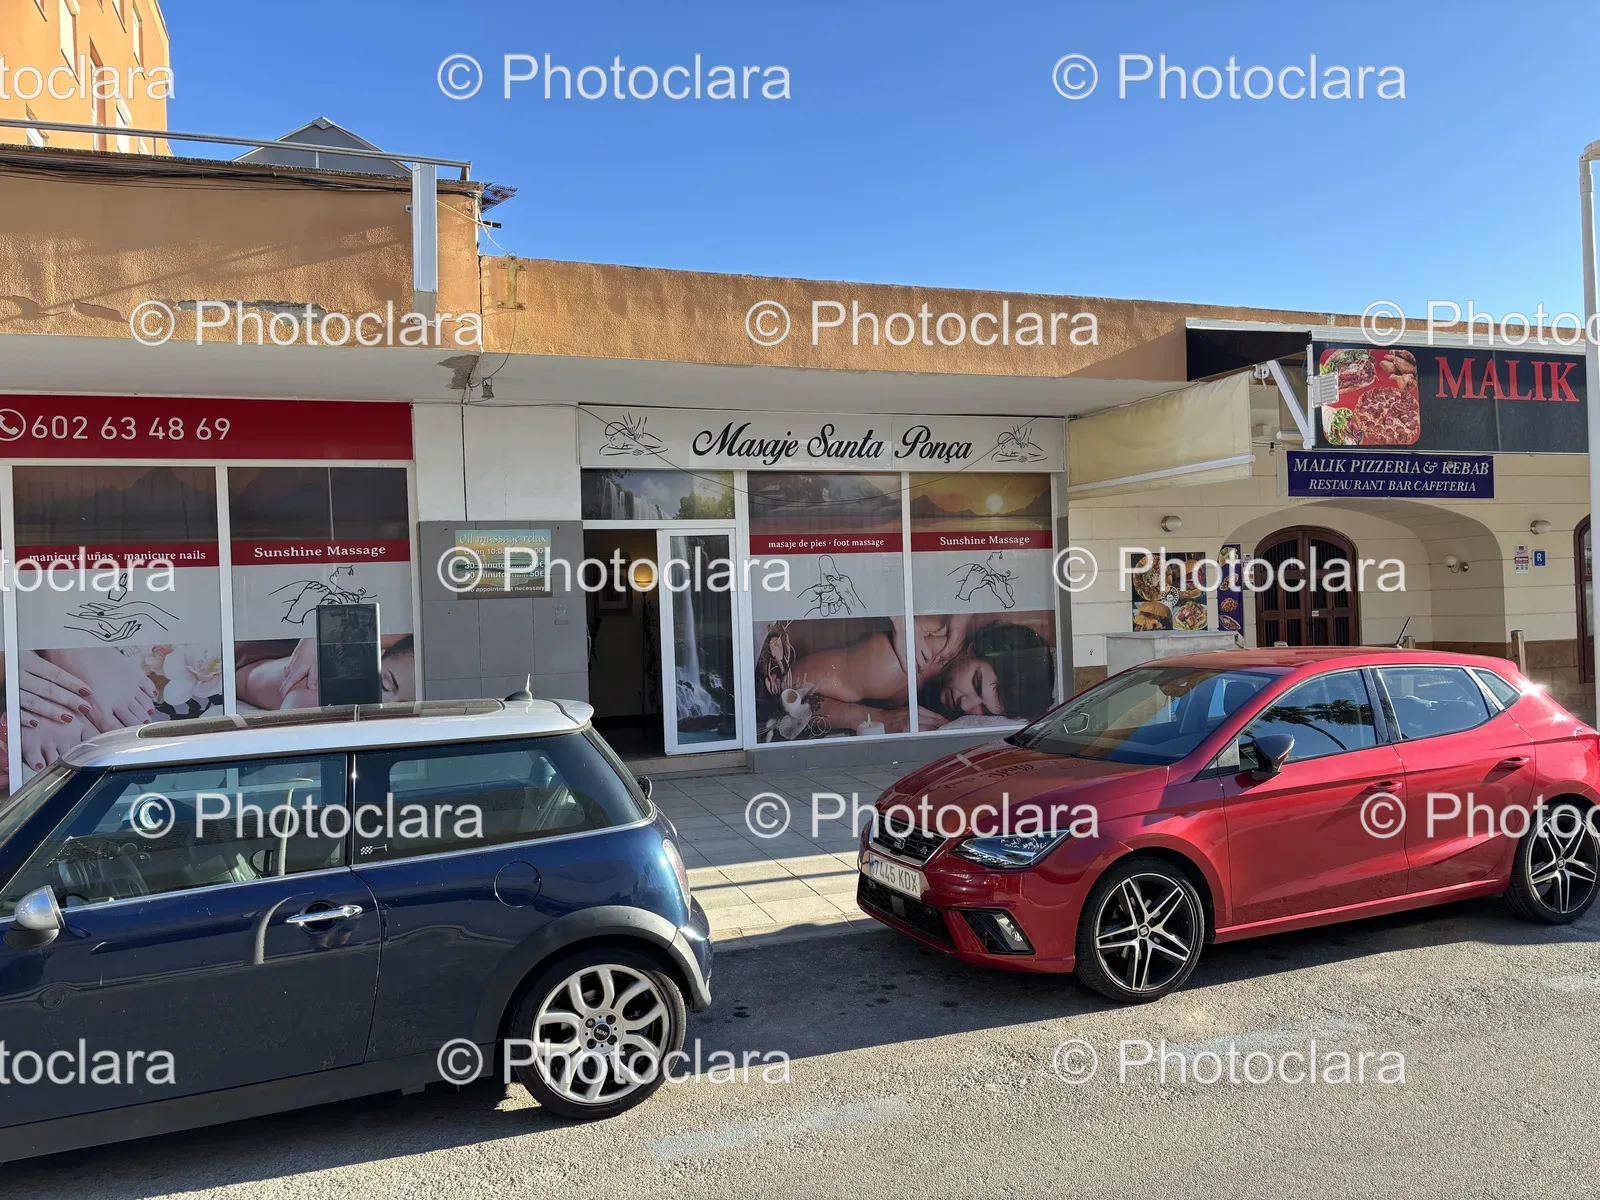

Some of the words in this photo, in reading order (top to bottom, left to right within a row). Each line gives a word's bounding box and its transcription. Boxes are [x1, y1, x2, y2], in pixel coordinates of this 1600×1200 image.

[1435, 357, 1580, 402] MALIK
[31, 415, 89, 440] 602
[100, 416, 137, 440] 63
[148, 417, 185, 440] 48
[195, 417, 231, 441] 69
[692, 421, 800, 466] Masaje
[806, 423, 885, 459] Santa
[894, 425, 974, 464] Ponça
[1293, 458, 1347, 473] MALIK
[1350, 459, 1421, 474] PIZZERIA
[1423, 461, 1438, 474] &
[1441, 461, 1490, 475] KEBAB
[1309, 479, 1386, 491] RESTAURANT
[1388, 480, 1412, 491] BAR
[1413, 480, 1477, 492] CAFETERIA
[459, 532, 473, 544] Oil
[476, 535, 521, 547] massage
[523, 532, 548, 543] relax
[768, 540, 797, 550] masaje
[799, 539, 809, 547] de
[810, 539, 827, 549] pies
[833, 538, 850, 547] foot
[852, 538, 885, 549] massage
[939, 536, 986, 547] Sunshine
[989, 535, 1030, 547] Massage
[29, 553, 83, 562] manicura
[87, 551, 114, 561] uñas
[123, 551, 176, 560] manicure
[179, 550, 206, 560] nails
[254, 547, 322, 558] Sunshine
[326, 546, 387, 557] Massage
[1536, 552, 1543, 562] R
[475, 586, 514, 594] appointmt
[874, 859, 896, 884] 7445
[898, 868, 918, 894] KDX
